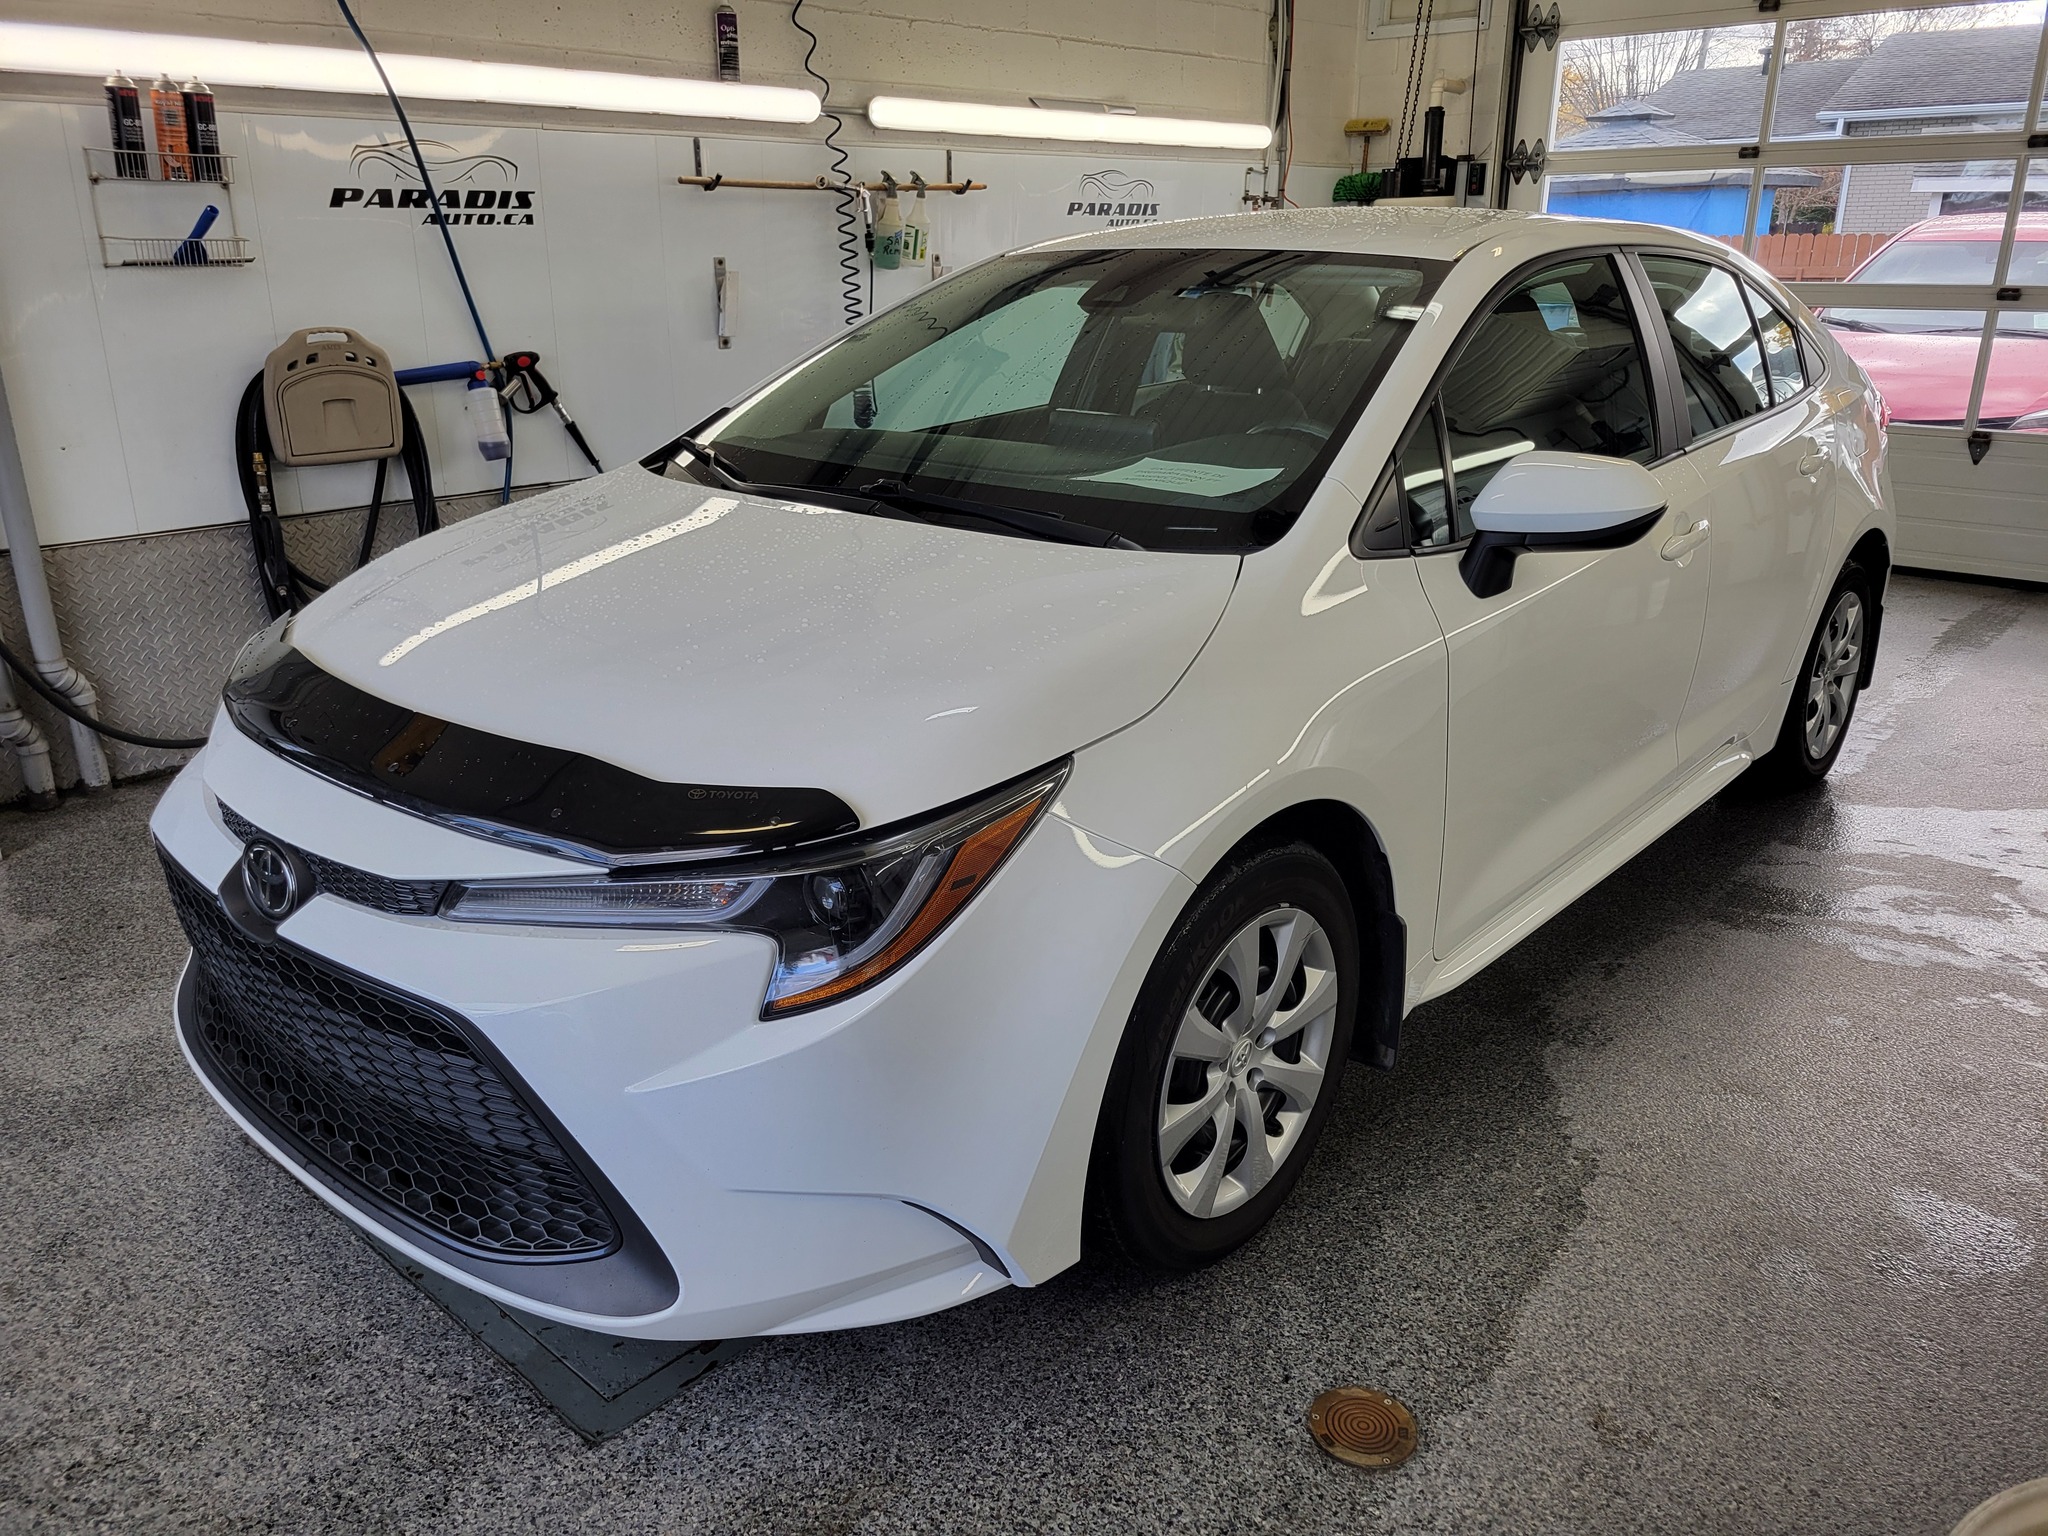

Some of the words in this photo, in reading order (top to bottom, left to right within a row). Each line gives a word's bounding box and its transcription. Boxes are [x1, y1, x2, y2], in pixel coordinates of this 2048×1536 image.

[329, 188, 536, 209] PARADIS
[1067, 202, 1160, 216] PARADIS
[421, 213, 535, 226] AUTO.CA
[709, 790, 759, 799] TOYOTA
